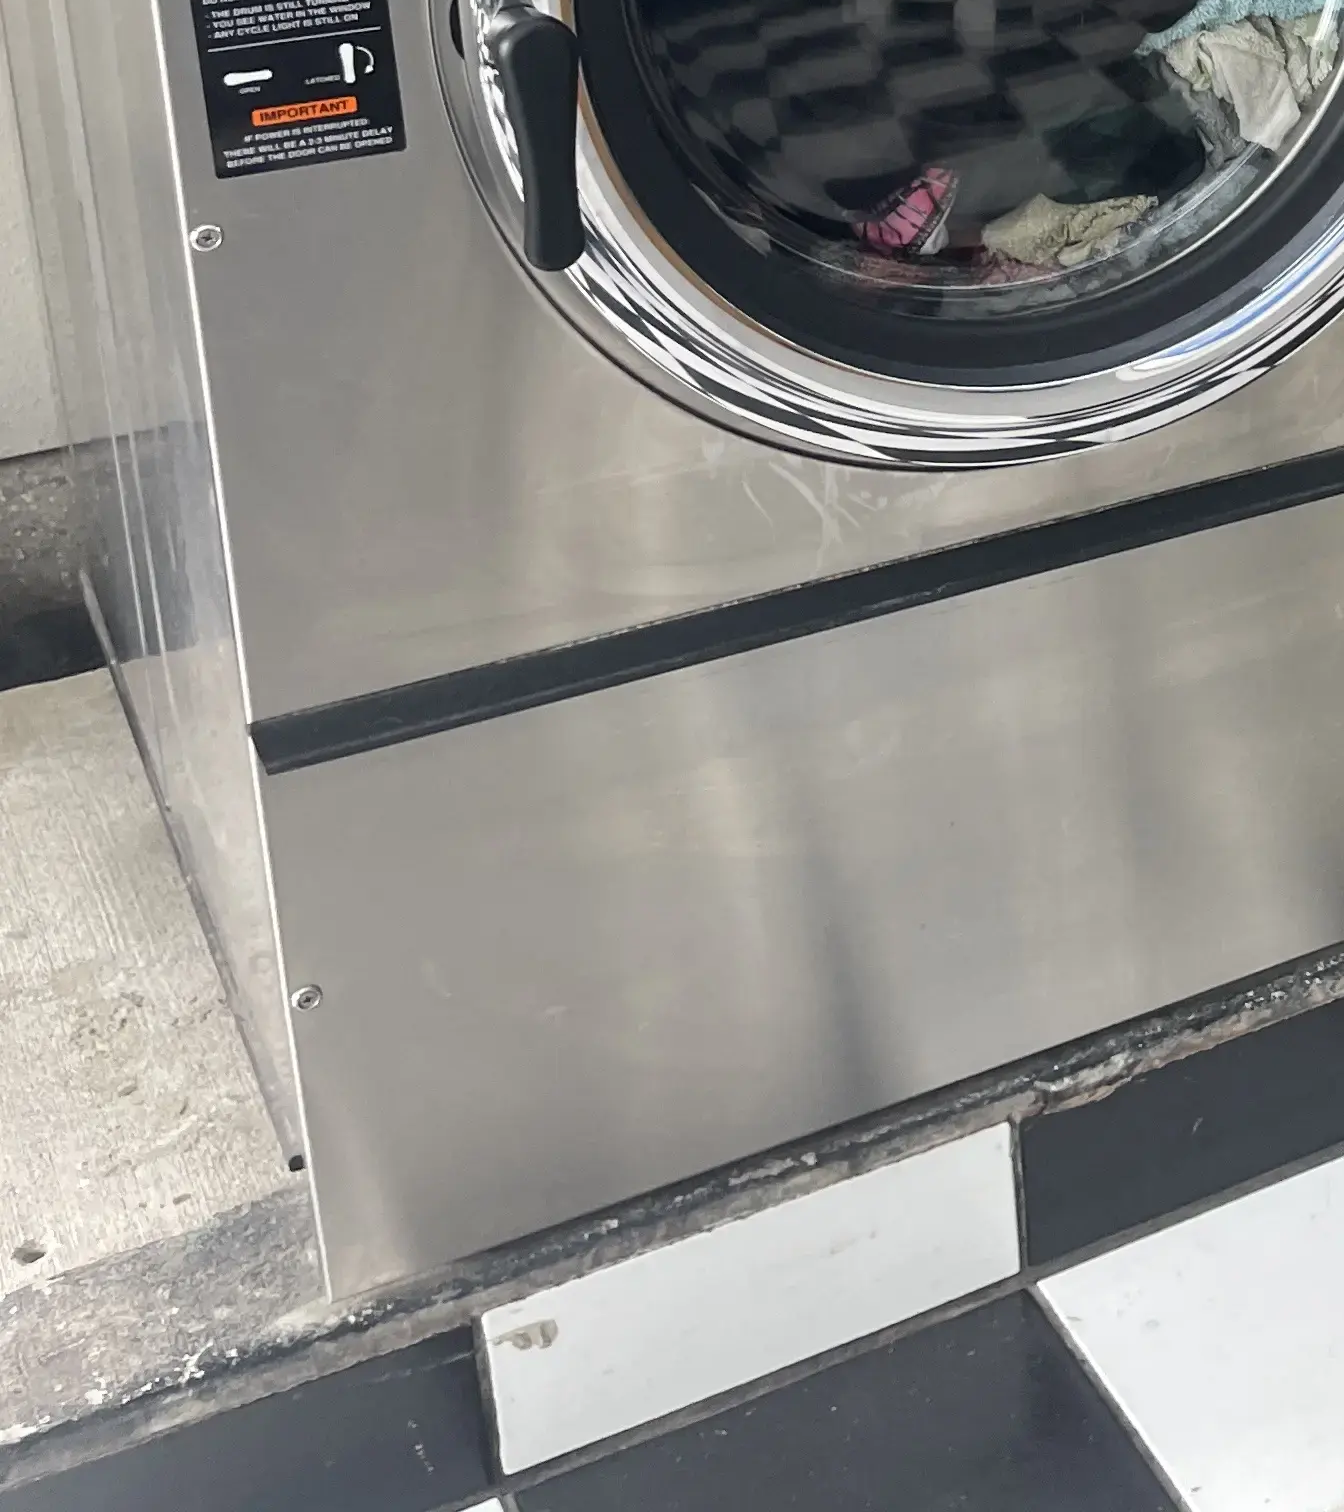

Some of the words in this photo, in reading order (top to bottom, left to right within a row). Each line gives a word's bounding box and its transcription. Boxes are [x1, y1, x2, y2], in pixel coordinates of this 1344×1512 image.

[211, 9, 230, 19] THE
[232, 5, 263, 16] DRUM
[276, 0, 303, 11] STILL
[212, 20, 234, 29] YOU
[257, 11, 294, 23] WATER
[307, 6, 327, 16] THE
[329, 1, 371, 14] WINDOW
[213, 29, 235, 39] ANY
[236, 25, 270, 37] CYCLE
[271, 21, 301, 31] LIGHT
[314, 15, 341, 26] STILL
[343, 13, 359, 22] ON
[259, 99, 350, 122] IMPORTANT
[254, 130, 290, 141] POWER
[258, 143, 281, 154] WILL
[283, 141, 297, 150] BE
[361, 126, 393, 138] DELAY
[267, 153, 286, 162] THE
[288, 148, 316, 159] DOOR
[317, 145, 338, 154] CAN
[354, 136, 393, 149] OPENED
